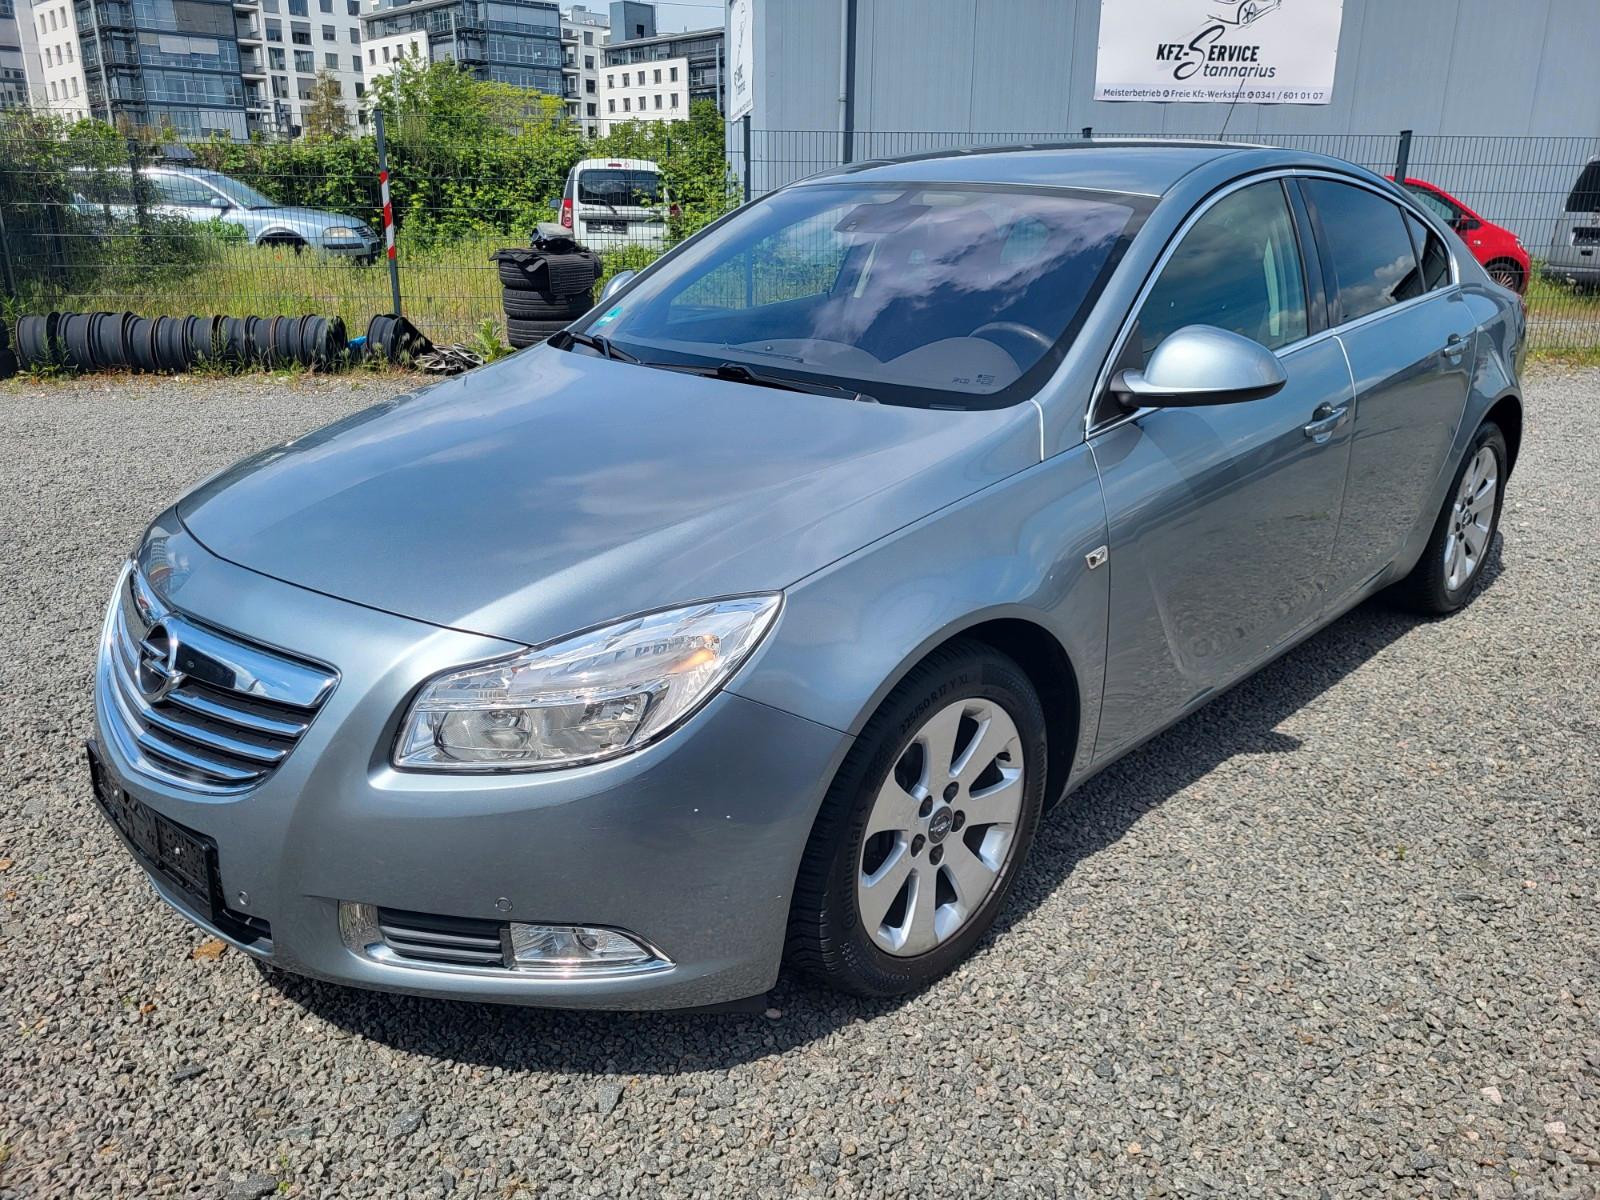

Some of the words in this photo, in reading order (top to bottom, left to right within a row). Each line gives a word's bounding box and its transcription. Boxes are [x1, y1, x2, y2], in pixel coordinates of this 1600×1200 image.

[1103, 88, 1161, 98] Meisterbetrieb
[1171, 90, 1191, 98] Freie
[1192, 90, 1246, 99] Kfz-Werkstatt
[1255, 91, 1275, 99] 0341
[1312, 92, 1324, 100] 07
